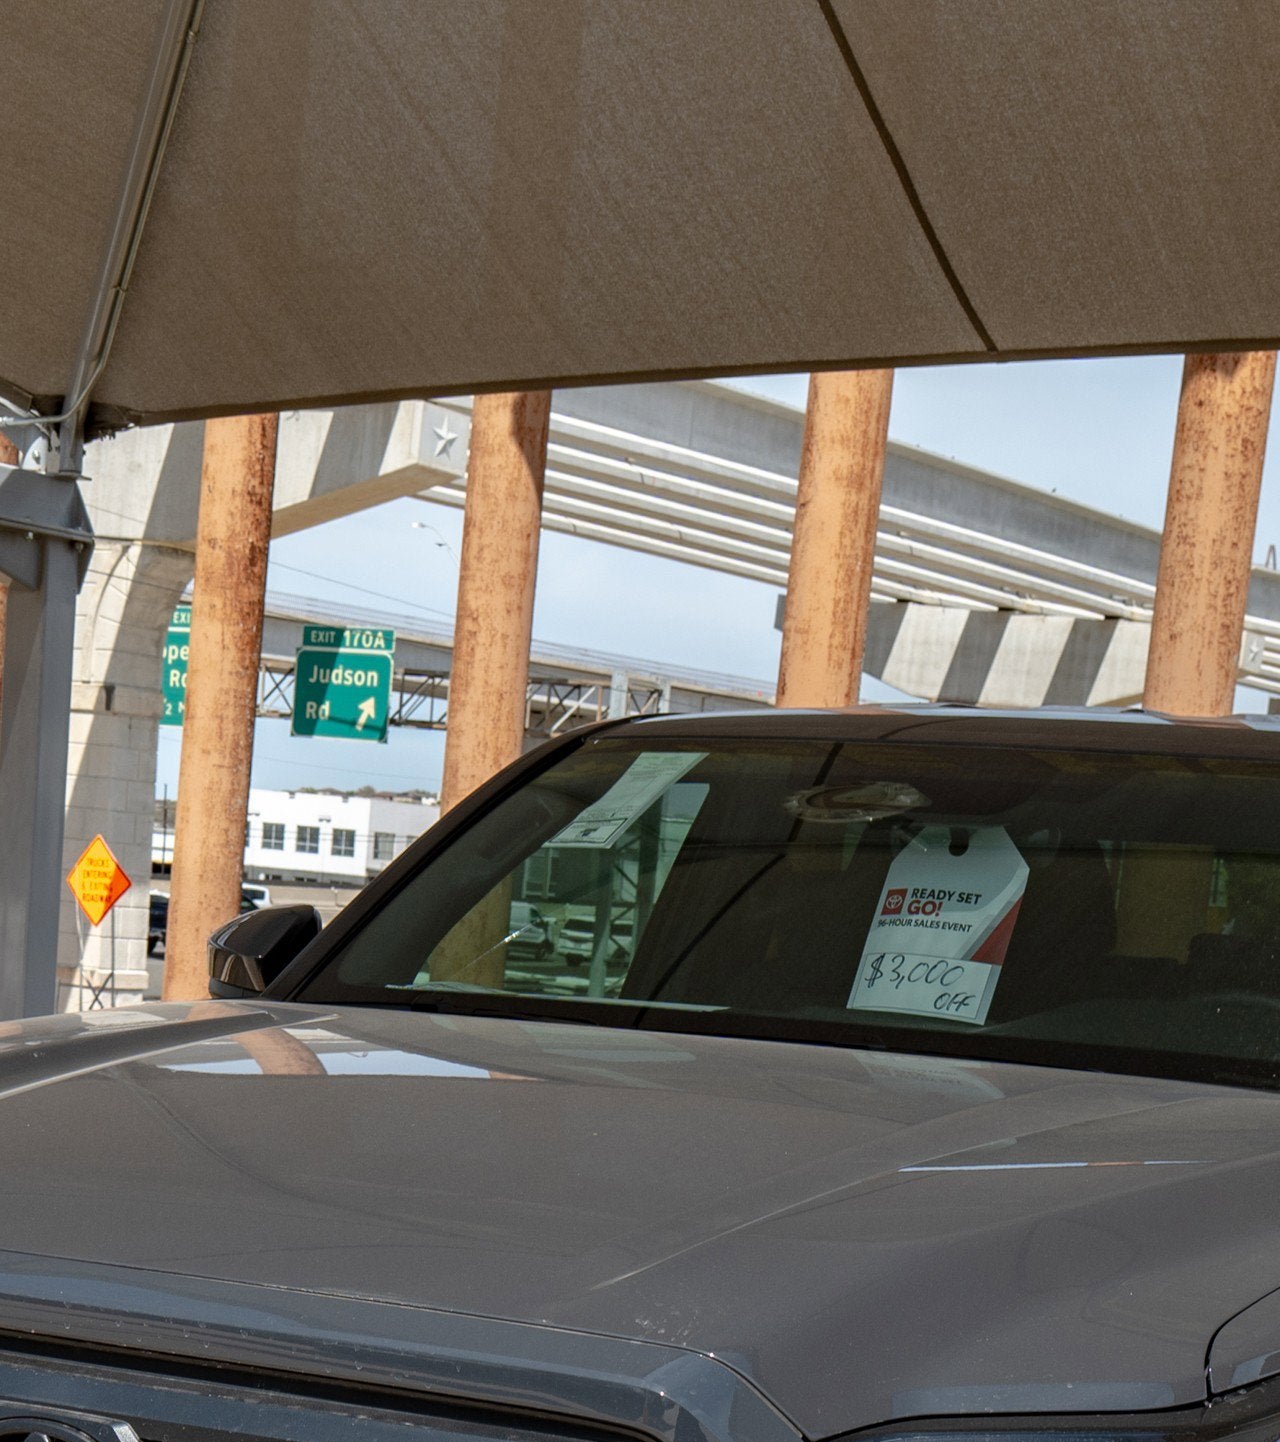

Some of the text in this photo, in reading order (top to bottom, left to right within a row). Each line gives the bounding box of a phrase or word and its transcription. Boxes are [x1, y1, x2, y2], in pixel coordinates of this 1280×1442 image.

[172, 610, 191, 624] EXI
[310, 629, 386, 649] EXIT 170A
[308, 664, 379, 688] Judson
[305, 700, 331, 721] Rd
[911, 887, 982, 905] READY SET
[907, 899, 944, 917] GO!
[913, 919, 941, 931] SALES
[941, 921, 973, 934] EVENT
[864, 952, 966, 989] $3,000
[933, 992, 976, 1012] OFF
